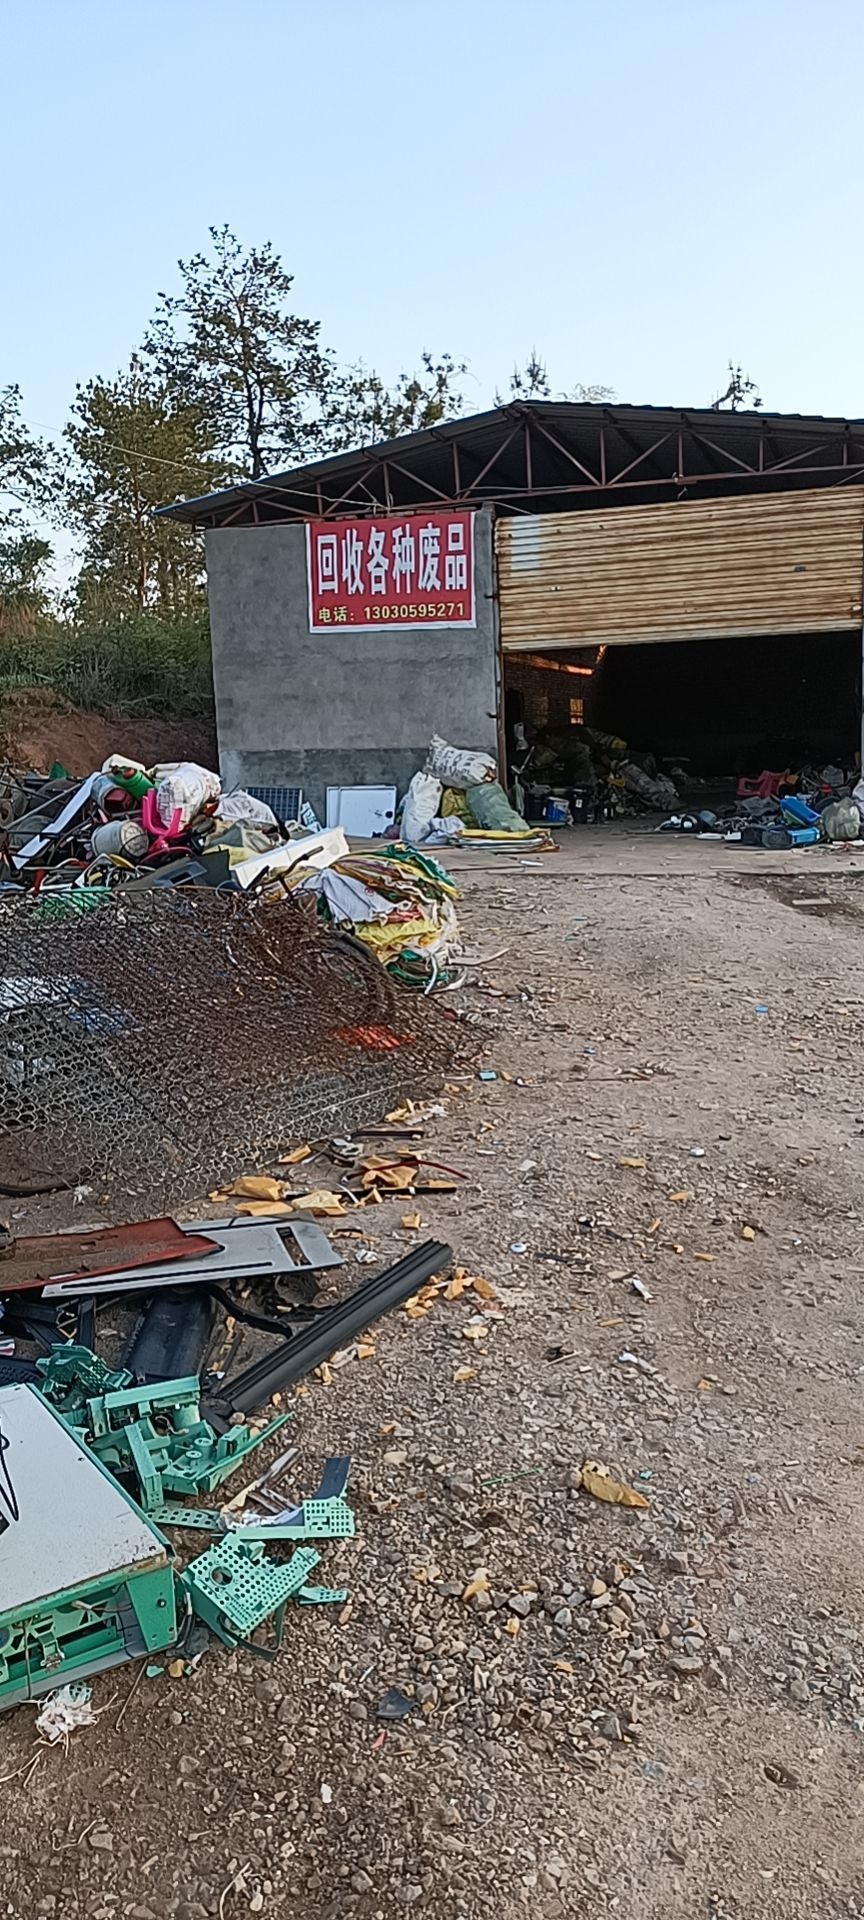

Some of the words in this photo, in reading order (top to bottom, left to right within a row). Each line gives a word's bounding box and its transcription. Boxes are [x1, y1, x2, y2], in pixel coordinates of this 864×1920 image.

[317, 522, 467, 595] 回收各种废品
